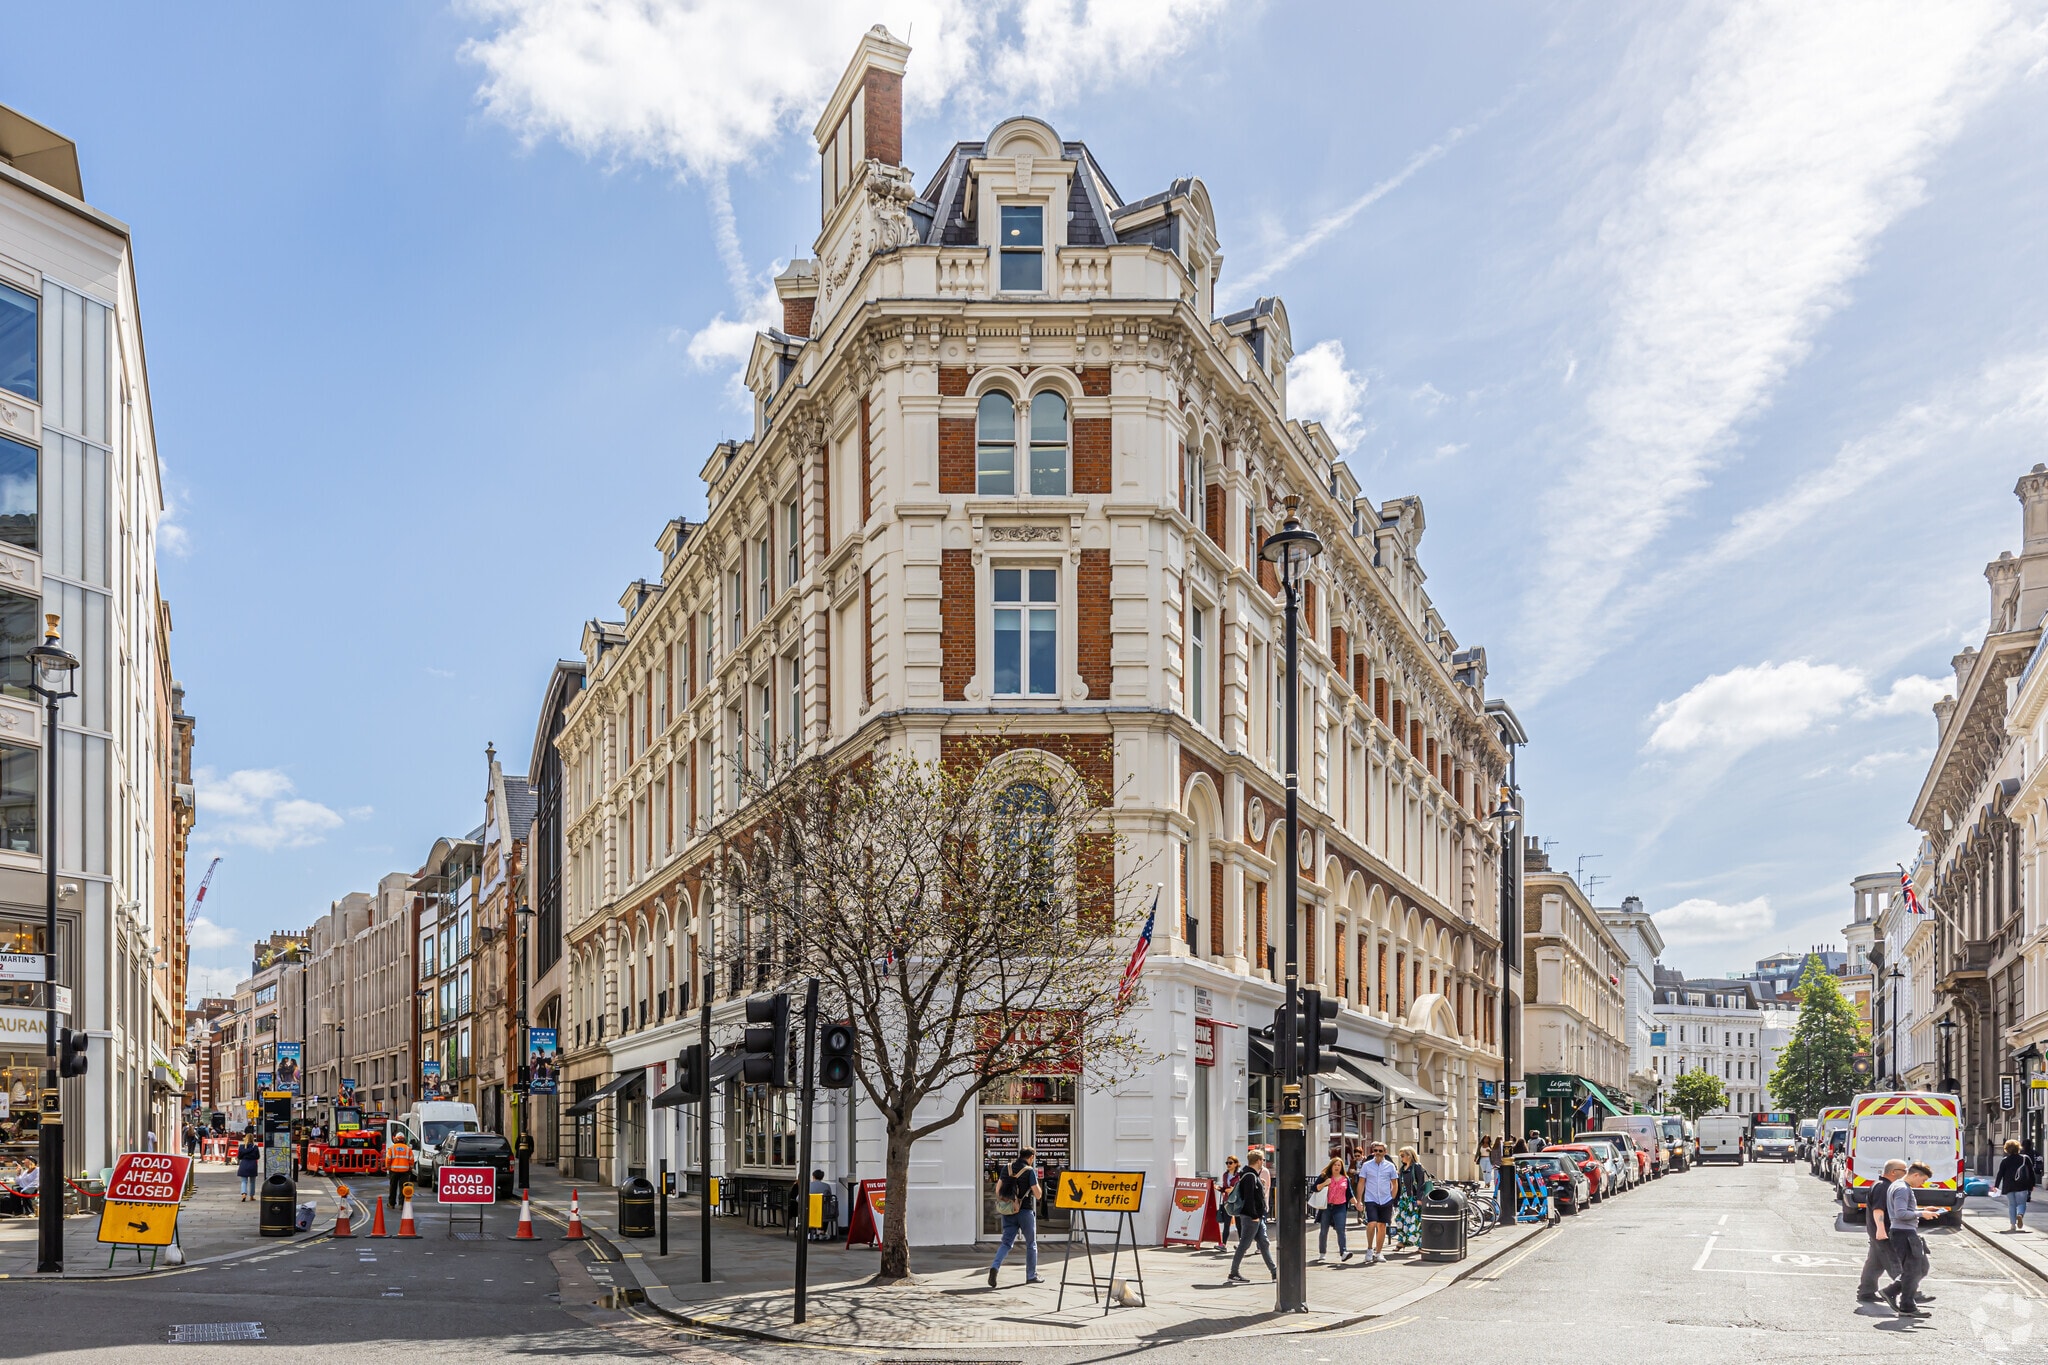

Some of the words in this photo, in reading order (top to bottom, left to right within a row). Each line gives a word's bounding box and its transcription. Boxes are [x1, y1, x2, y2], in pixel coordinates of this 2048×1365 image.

[0, 955, 36, 964] MARTIN'S
[1196, 1025, 1212, 1042] FIVE
[1195, 1042, 1213, 1060] GUYS
[1860, 1135, 1903, 1143] openreach
[131, 1157, 172, 1169] ROAD
[123, 1170, 173, 1184] AHEAD
[449, 1174, 484, 1184] ROAD
[116, 1183, 174, 1198] CLOSED
[442, 1185, 493, 1195] CLOSED
[1091, 1180, 1138, 1192] Diverted
[1095, 1194, 1130, 1205] traffic
